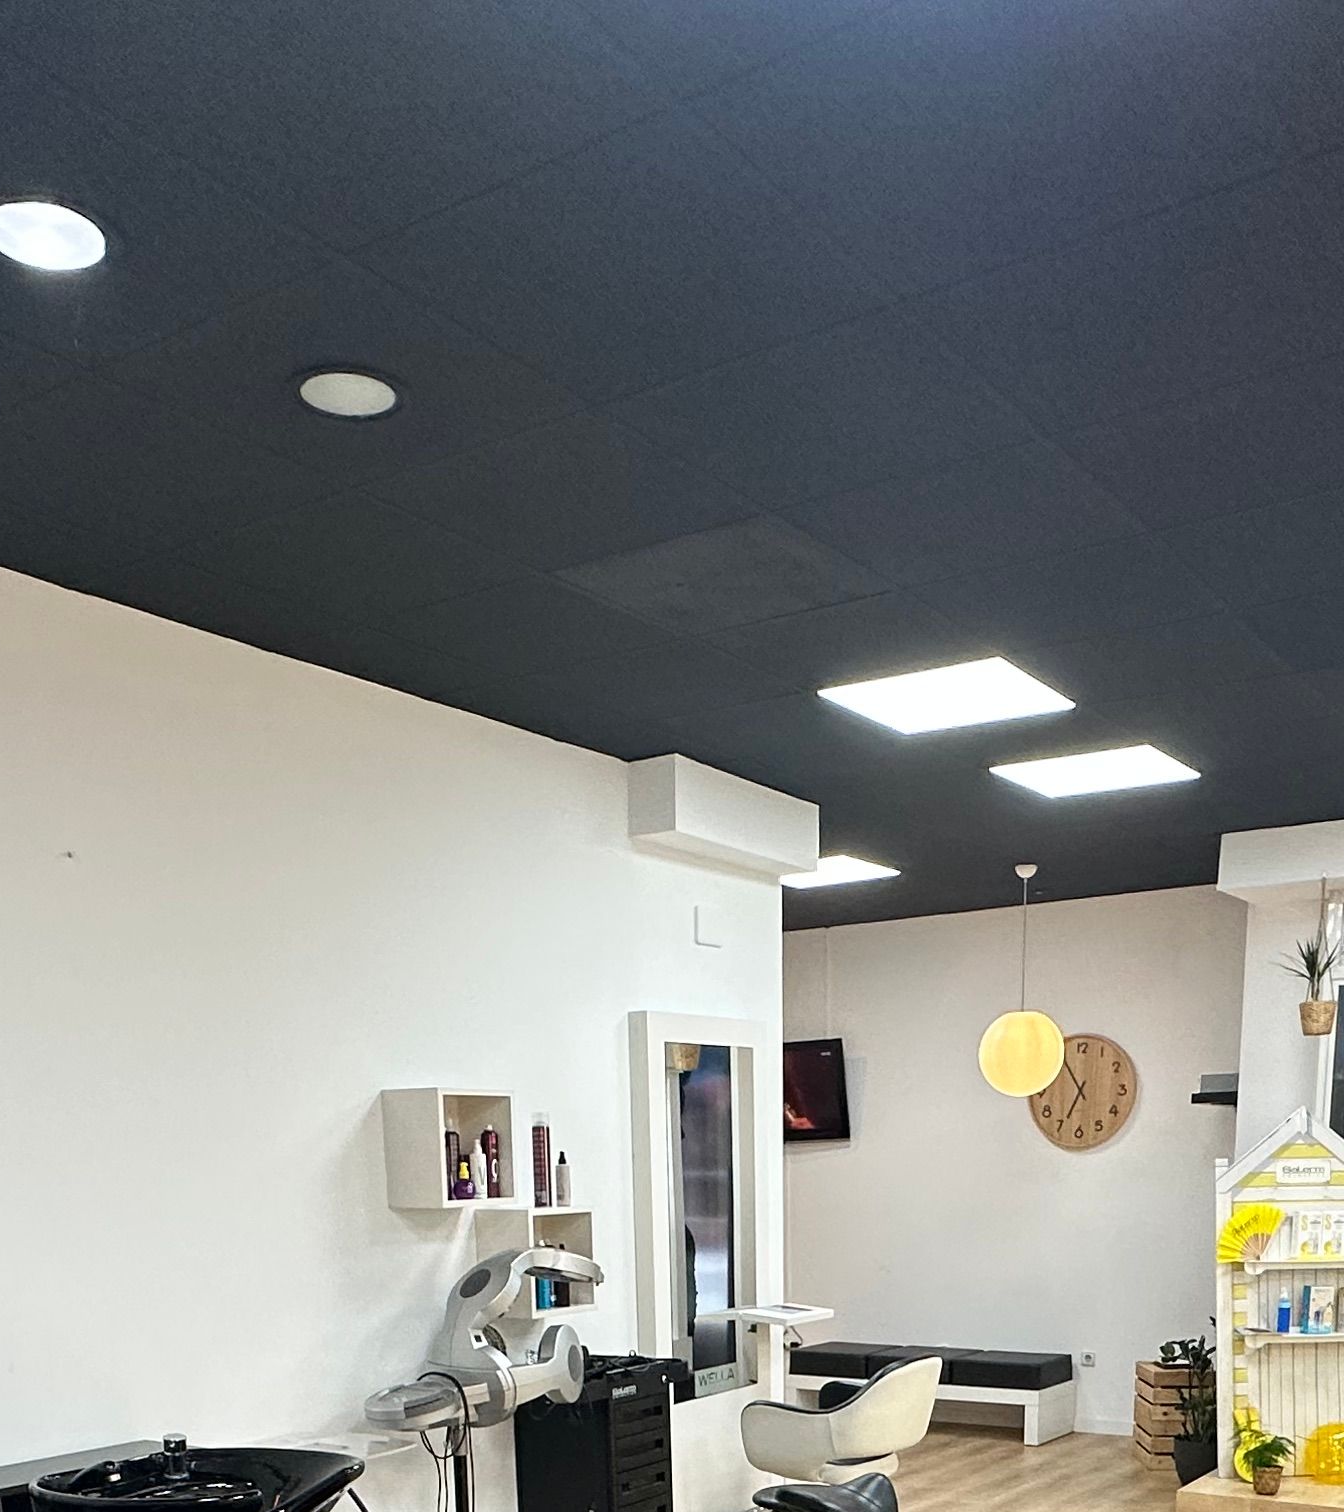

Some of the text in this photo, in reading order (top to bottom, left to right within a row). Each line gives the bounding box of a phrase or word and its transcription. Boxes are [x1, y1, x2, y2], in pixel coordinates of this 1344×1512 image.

[1077, 1042, 1089, 1054] 12
[1112, 1061, 1121, 1073] 2
[1117, 1083, 1127, 1096] 3
[1041, 1104, 1052, 1118] 8
[1109, 1104, 1119, 1117] 4
[1056, 1120, 1064, 1132] 7
[1074, 1124, 1084, 1139] 6
[1094, 1120, 1104, 1132] 5
[698, 1368, 735, 1387] WELLA
